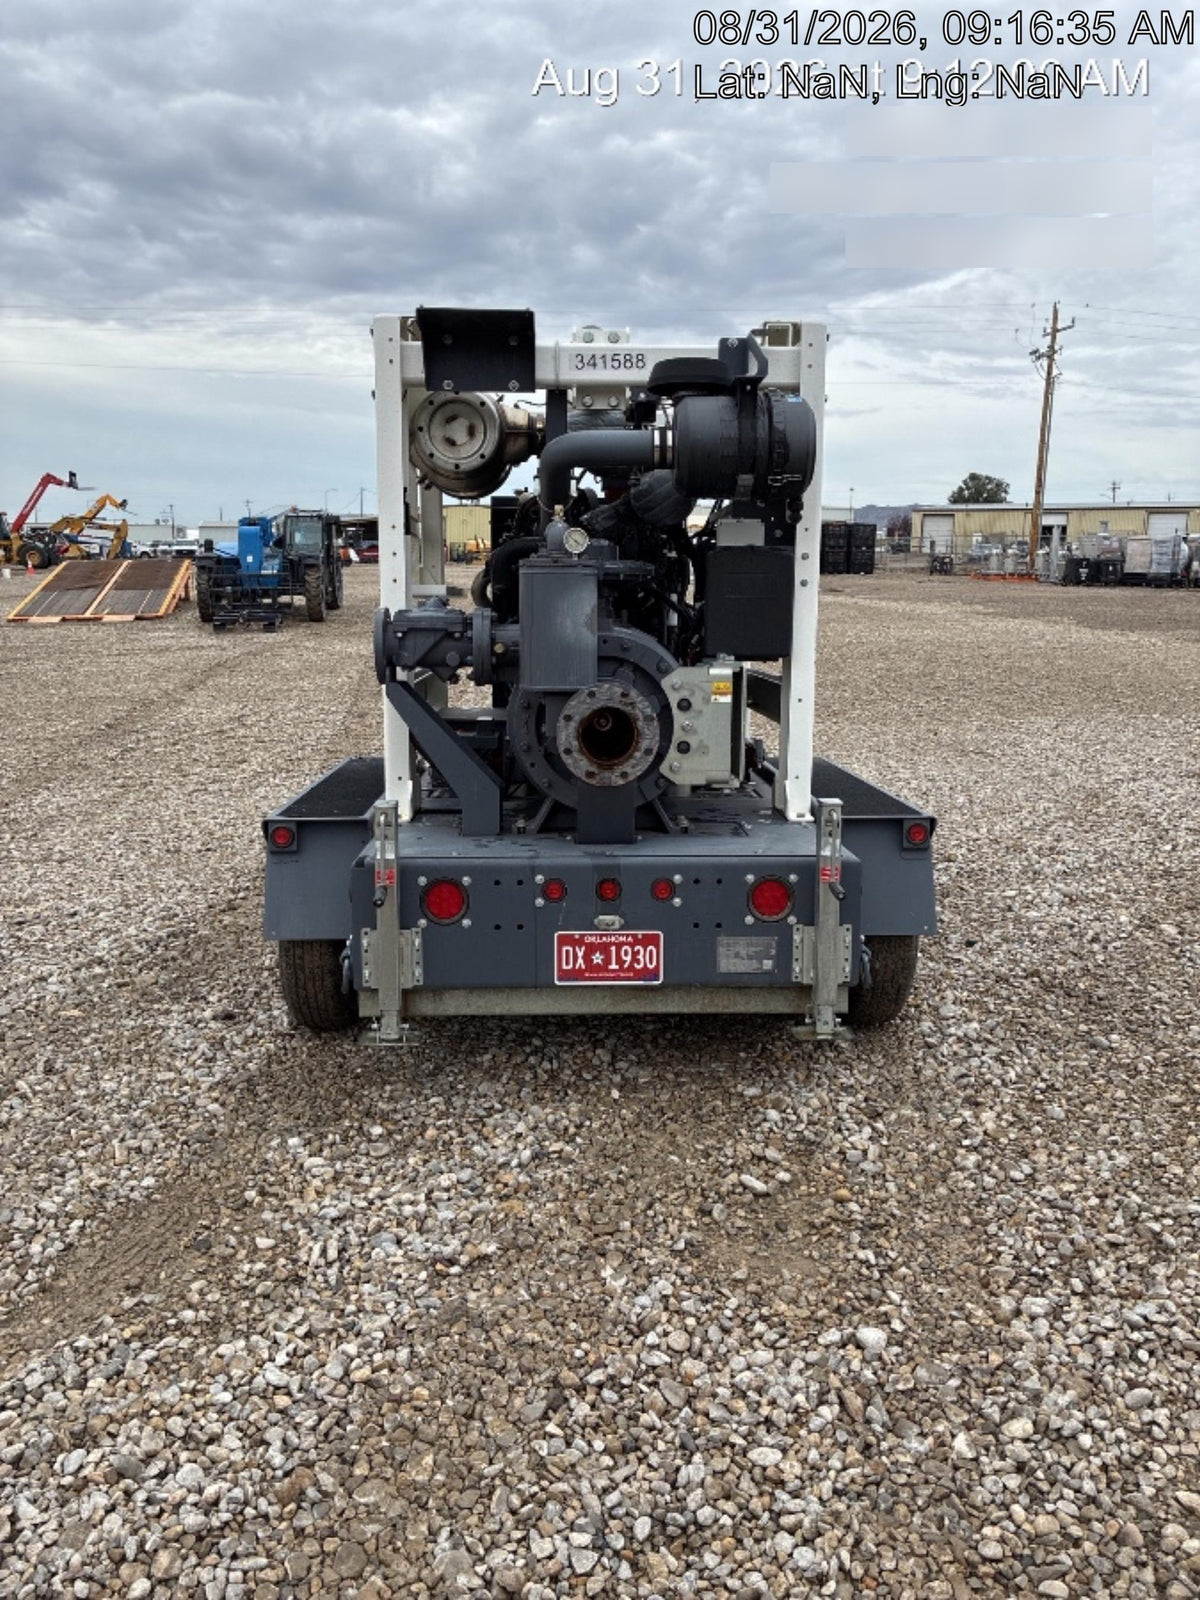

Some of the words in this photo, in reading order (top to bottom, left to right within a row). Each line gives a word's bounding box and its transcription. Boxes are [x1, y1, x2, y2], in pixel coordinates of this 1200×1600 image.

[575, 353, 646, 370] 341588
[584, 935, 633, 943] OKLAHOMA
[562, 946, 585, 969] DX
[608, 945, 657, 969] 1930
